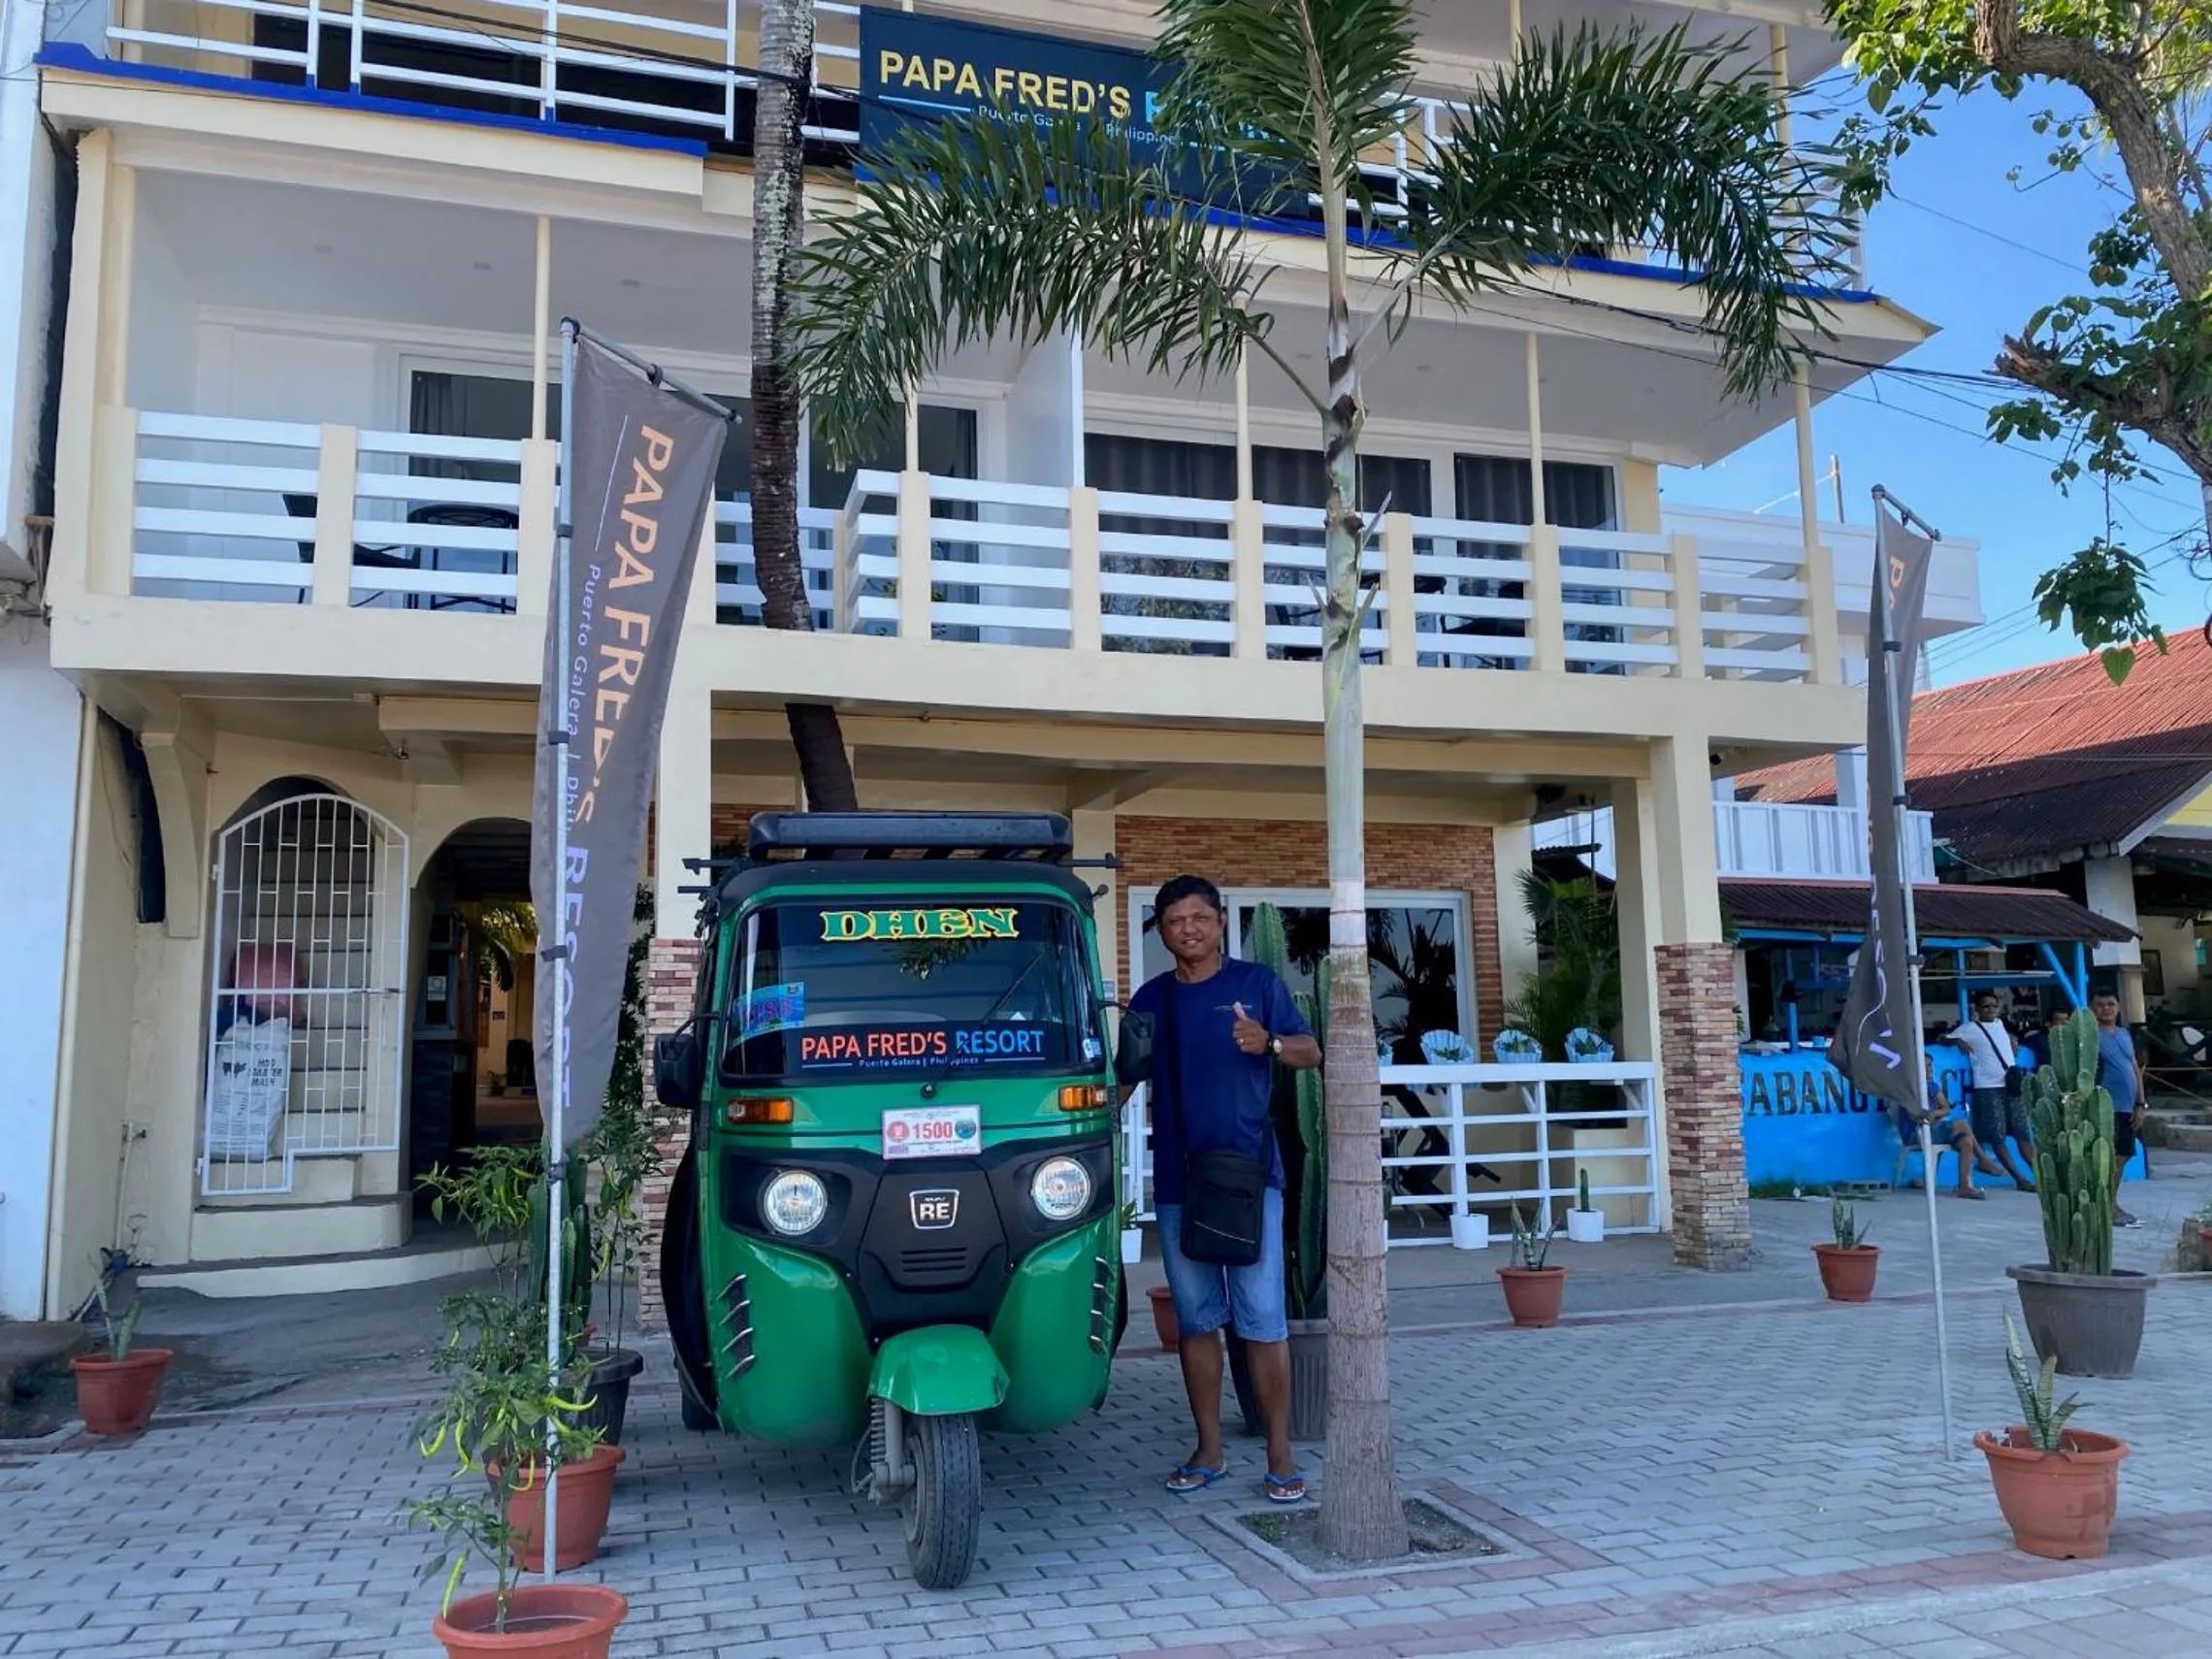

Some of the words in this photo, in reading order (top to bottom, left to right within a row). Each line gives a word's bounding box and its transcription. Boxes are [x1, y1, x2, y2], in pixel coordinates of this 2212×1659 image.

[880, 49, 982, 98] PAPA
[994, 67, 1131, 119] FRED'S
[608, 424, 675, 590] PAPA
[577, 564, 602, 646] Puerto
[568, 656, 587, 735] Galera
[801, 1035, 862, 1060] PAPA
[867, 1031, 947, 1057] FRED'S
[956, 1029, 1045, 1054] RESORT
[859, 1058, 890, 1068] Puerto
[892, 1057, 921, 1066] Galera
[929, 1056, 979, 1066] Philpines
[913, 1121, 954, 1140] 1500
[920, 1202, 950, 1220] RE
